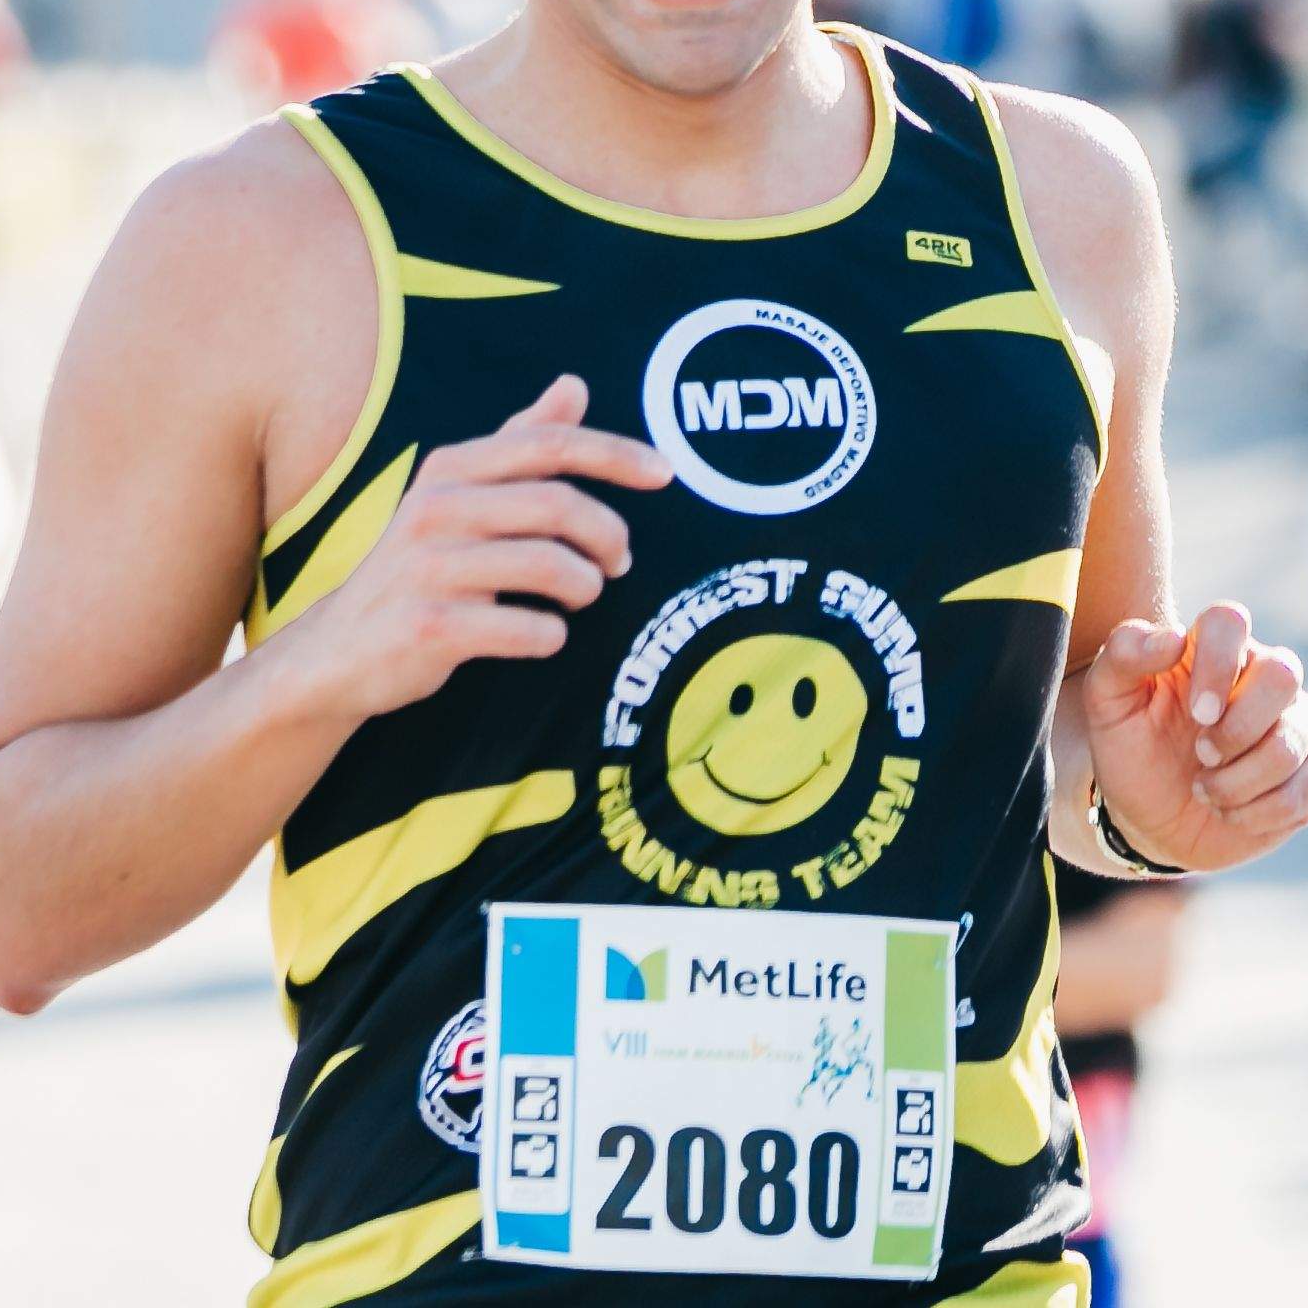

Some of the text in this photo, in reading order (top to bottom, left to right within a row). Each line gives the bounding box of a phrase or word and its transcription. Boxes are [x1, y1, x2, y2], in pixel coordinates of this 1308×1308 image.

[679, 377, 845, 432] MDM
[756, 308, 869, 499] MASAJE DEPORTIVO MADRID
[597, 755, 921, 910] RUNNNG TEAM
[689, 956, 868, 1003] MetLife
[603, 1028, 648, 1059] VIII
[595, 1124, 861, 1239] 2080
